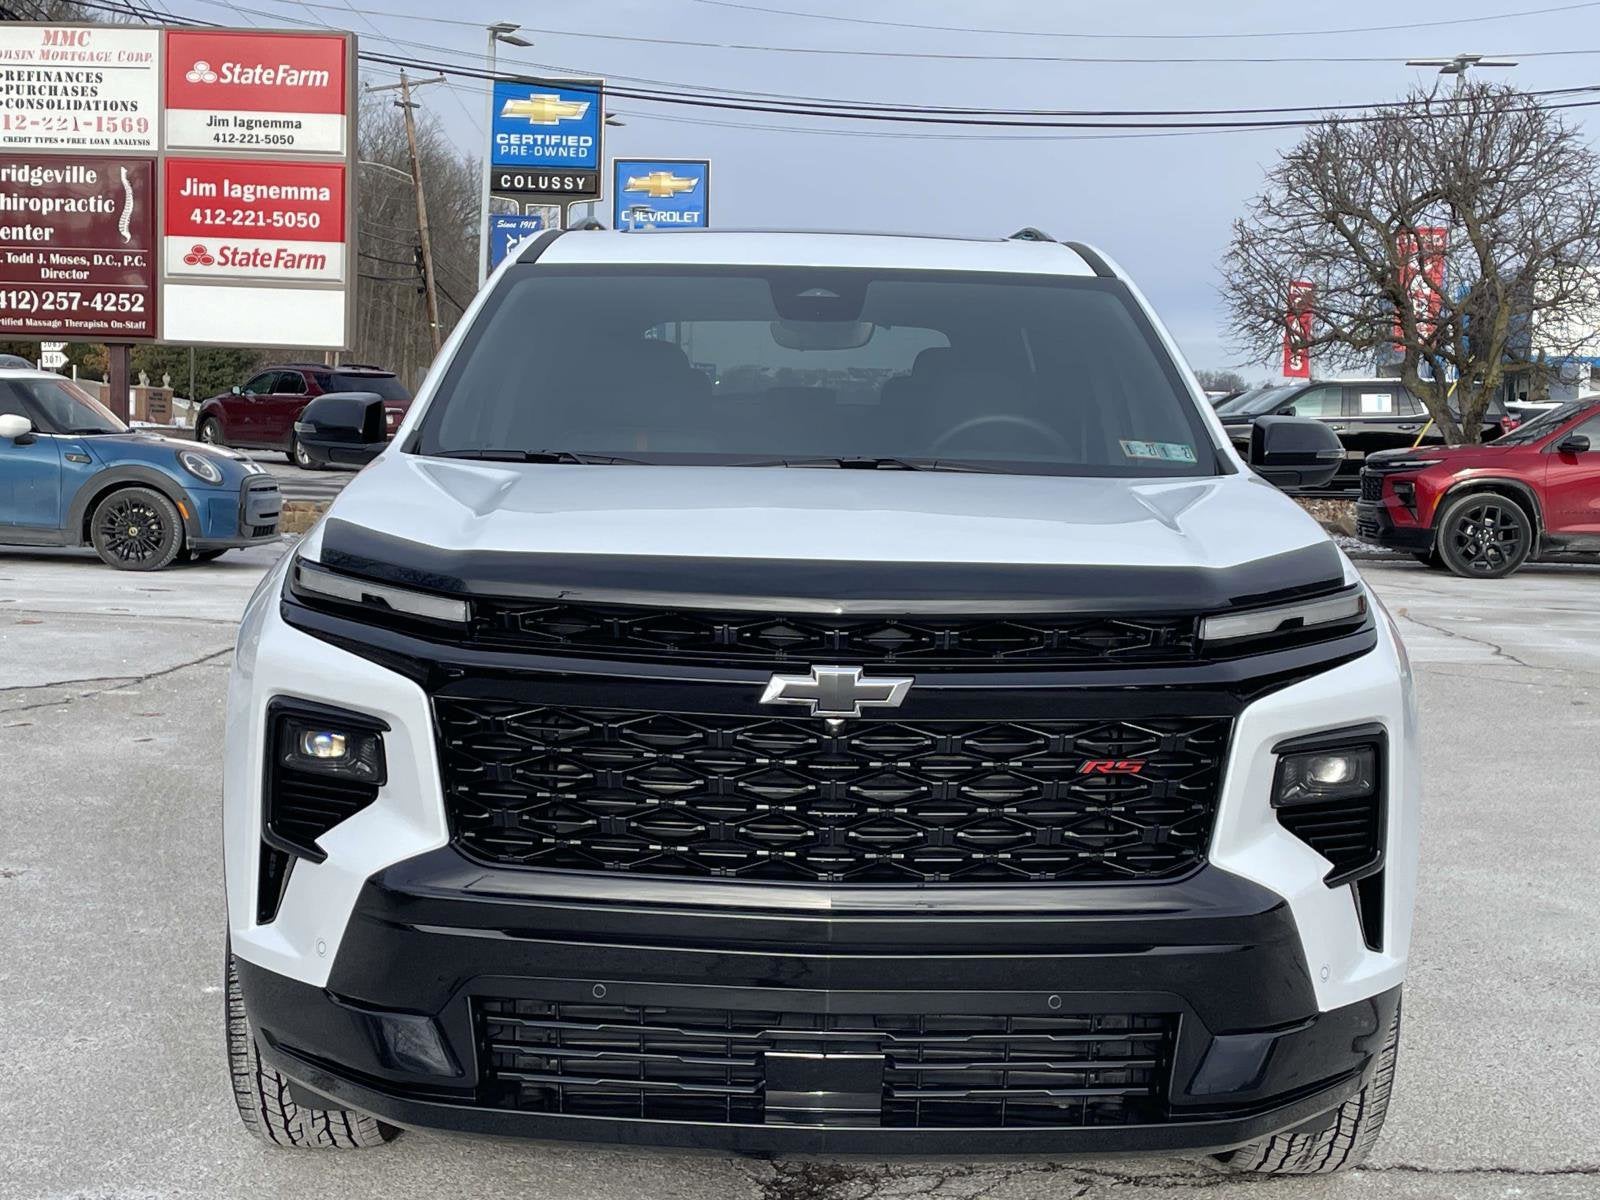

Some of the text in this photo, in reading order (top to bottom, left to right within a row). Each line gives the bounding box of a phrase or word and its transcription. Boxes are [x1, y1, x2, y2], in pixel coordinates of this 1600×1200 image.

[41, 29, 92, 48] MMC
[0, 49, 35, 60] NSIN
[39, 49, 113, 63] MORTGAGE
[5, 70, 103, 83] REFINANCES
[5, 84, 98, 97] PURCHASES
[5, 97, 138, 112] CONSOLIDATIONS
[3, 113, 149, 134] 12-221-1569
[206, 115, 302, 131] Jim Iagnemma
[3, 136, 150, 146] CREDIT TYPES FREE LOAN ANALYSIS
[213, 133, 295, 146] 412-221-5050
[496, 133, 592, 147] CERTIFIED
[500, 146, 588, 158] PRE-OWNED
[0, 164, 97, 187] ridgeville
[501, 174, 586, 190] COLUSSY
[180, 177, 331, 203] Jim Iagnemma
[0, 192, 115, 215] hiropractic
[190, 207, 321, 229] 412-221-5050
[496, 219, 537, 229] Since 1918
[0, 223, 54, 241] enter
[5, 252, 33, 264] Todd
[37, 253, 47, 264] J.
[49, 253, 90, 267] Moses,
[41, 267, 90, 280] Director
[0, 290, 145, 313] 412) 257-4252
[25, 318, 62, 329] Massage
[64, 318, 108, 330] Therapists
[110, 319, 146, 331] On-Staff
[1076, 758, 1147, 774] RS
